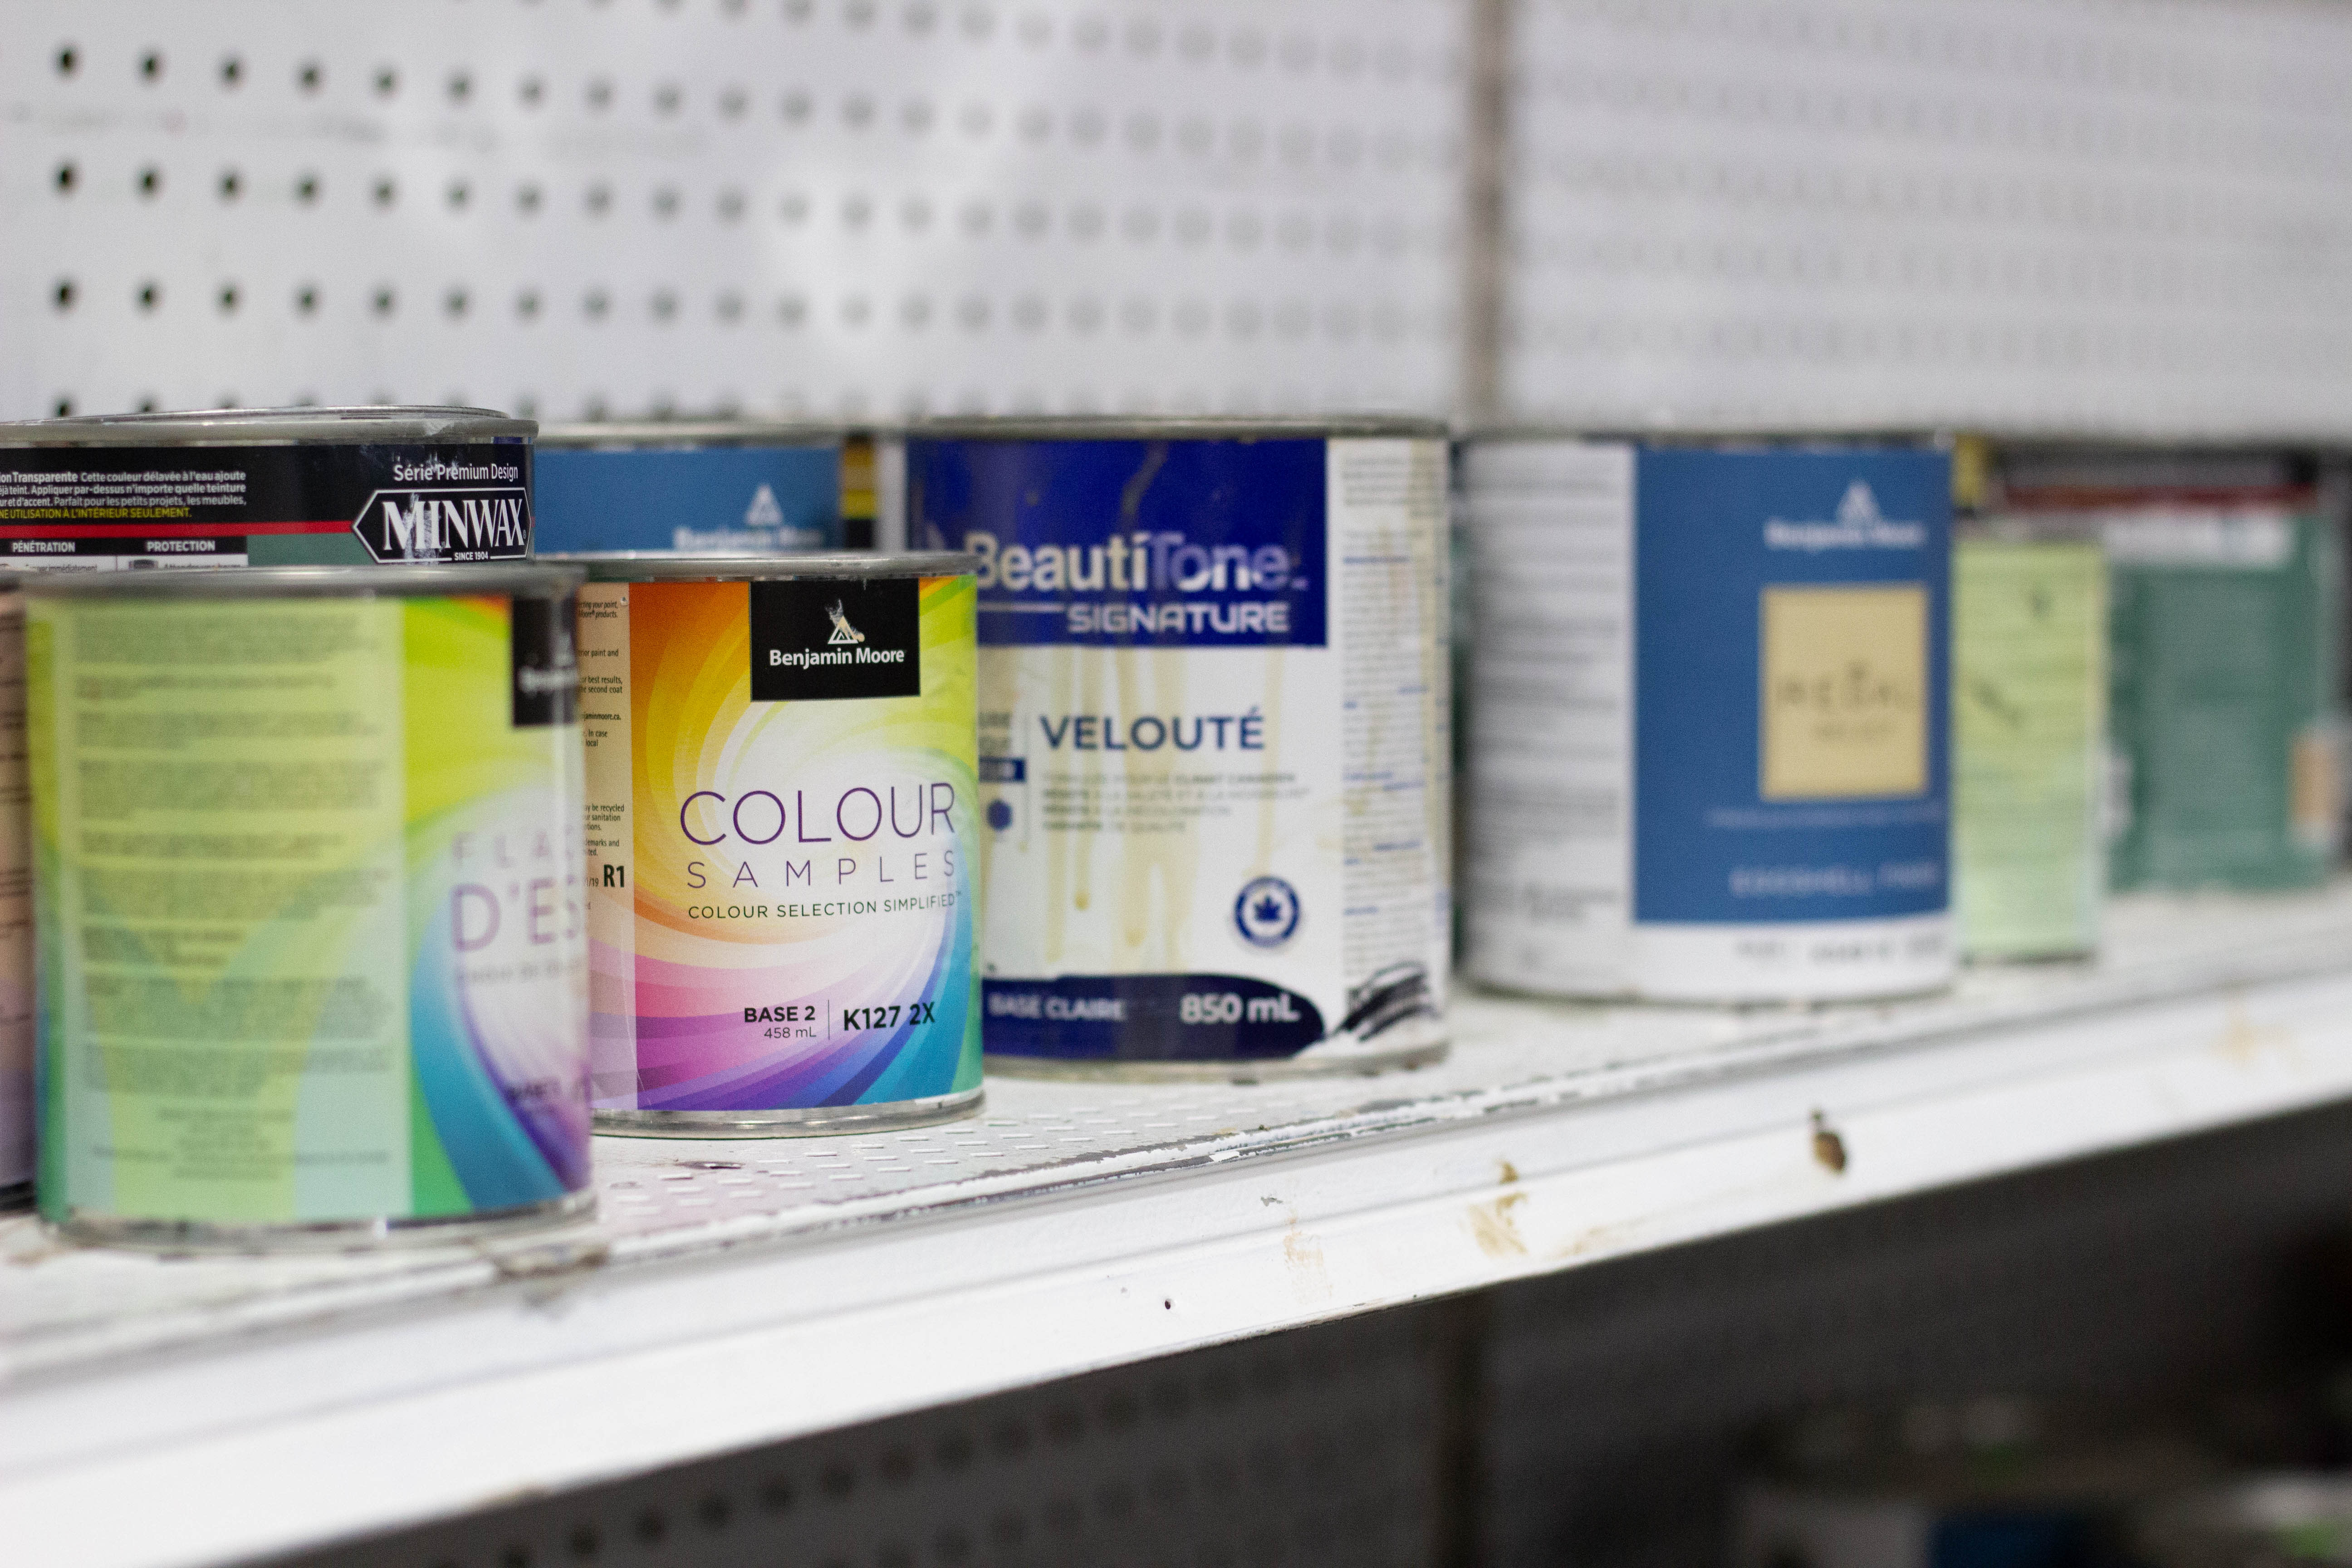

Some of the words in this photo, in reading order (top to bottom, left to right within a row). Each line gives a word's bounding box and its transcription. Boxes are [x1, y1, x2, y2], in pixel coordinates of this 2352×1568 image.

[12, 471, 78, 484] Transparente
[81, 472, 106, 482] Cette
[107, 472, 142, 482] couleur
[143, 471, 181, 481] délavée
[215, 470, 246, 482] ajoute
[393, 464, 433, 481] Série
[437, 464, 489, 480] Premium
[491, 463, 518, 482] Design
[10, 485, 29, 495] teint.
[31, 485, 73, 496] Appliquer
[74, 484, 124, 495] par-dessus
[126, 483, 173, 495] n'importe
[175, 483, 205, 495] quelle
[206, 483, 246, 493] teinture
[8, 498, 15, 507] et
[16, 497, 53, 507] d'accent.
[54, 497, 83, 506] Parfait
[84, 498, 105, 508] pour
[107, 497, 120, 506] les
[121, 496, 147, 506] petits
[149, 496, 186, 507] projets,
[186, 495, 201, 505] les
[202, 495, 246, 506] meubles,
[10, 508, 61, 519] UTILISATION
[72, 507, 128, 518] L'INTÉRIEUR
[130, 507, 192, 518] SEULEMENT.
[12, 541, 75, 552] PÉNÉTRATION
[146, 540, 216, 552] PROTECTION
[455, 552, 473, 561] SINCE
[475, 551, 489, 560] 1904
[604, 601, 618, 609] paint,
[595, 610, 617, 619] products.
[1068, 603, 1289, 634] SIGNATURE
[591, 649, 605, 658] paint
[770, 648, 852, 670] Benjamin
[856, 647, 905, 663] Moore
[602, 676, 622, 685] results,
[1040, 706, 1264, 752] VELOUTÉ
[592, 804, 598, 812] be
[600, 804, 624, 813] recycled
[681, 783, 955, 845] COLOUR
[592, 813, 621, 822] sanitation
[603, 864, 624, 887] R1
[687, 850, 954, 889] SAMPLES
[688, 905, 768, 919] COLOUR
[777, 901, 877, 917] SELECTION
[1181, 993, 1244, 1024] 850
[1248, 992, 1301, 1023] mL
[744, 1006, 799, 1023] BASE
[804, 1005, 815, 1021] 2
[843, 1005, 901, 1031] K127
[909, 1001, 936, 1025] 2X
[764, 1027, 790, 1039] 458
[796, 1026, 817, 1038] mL
